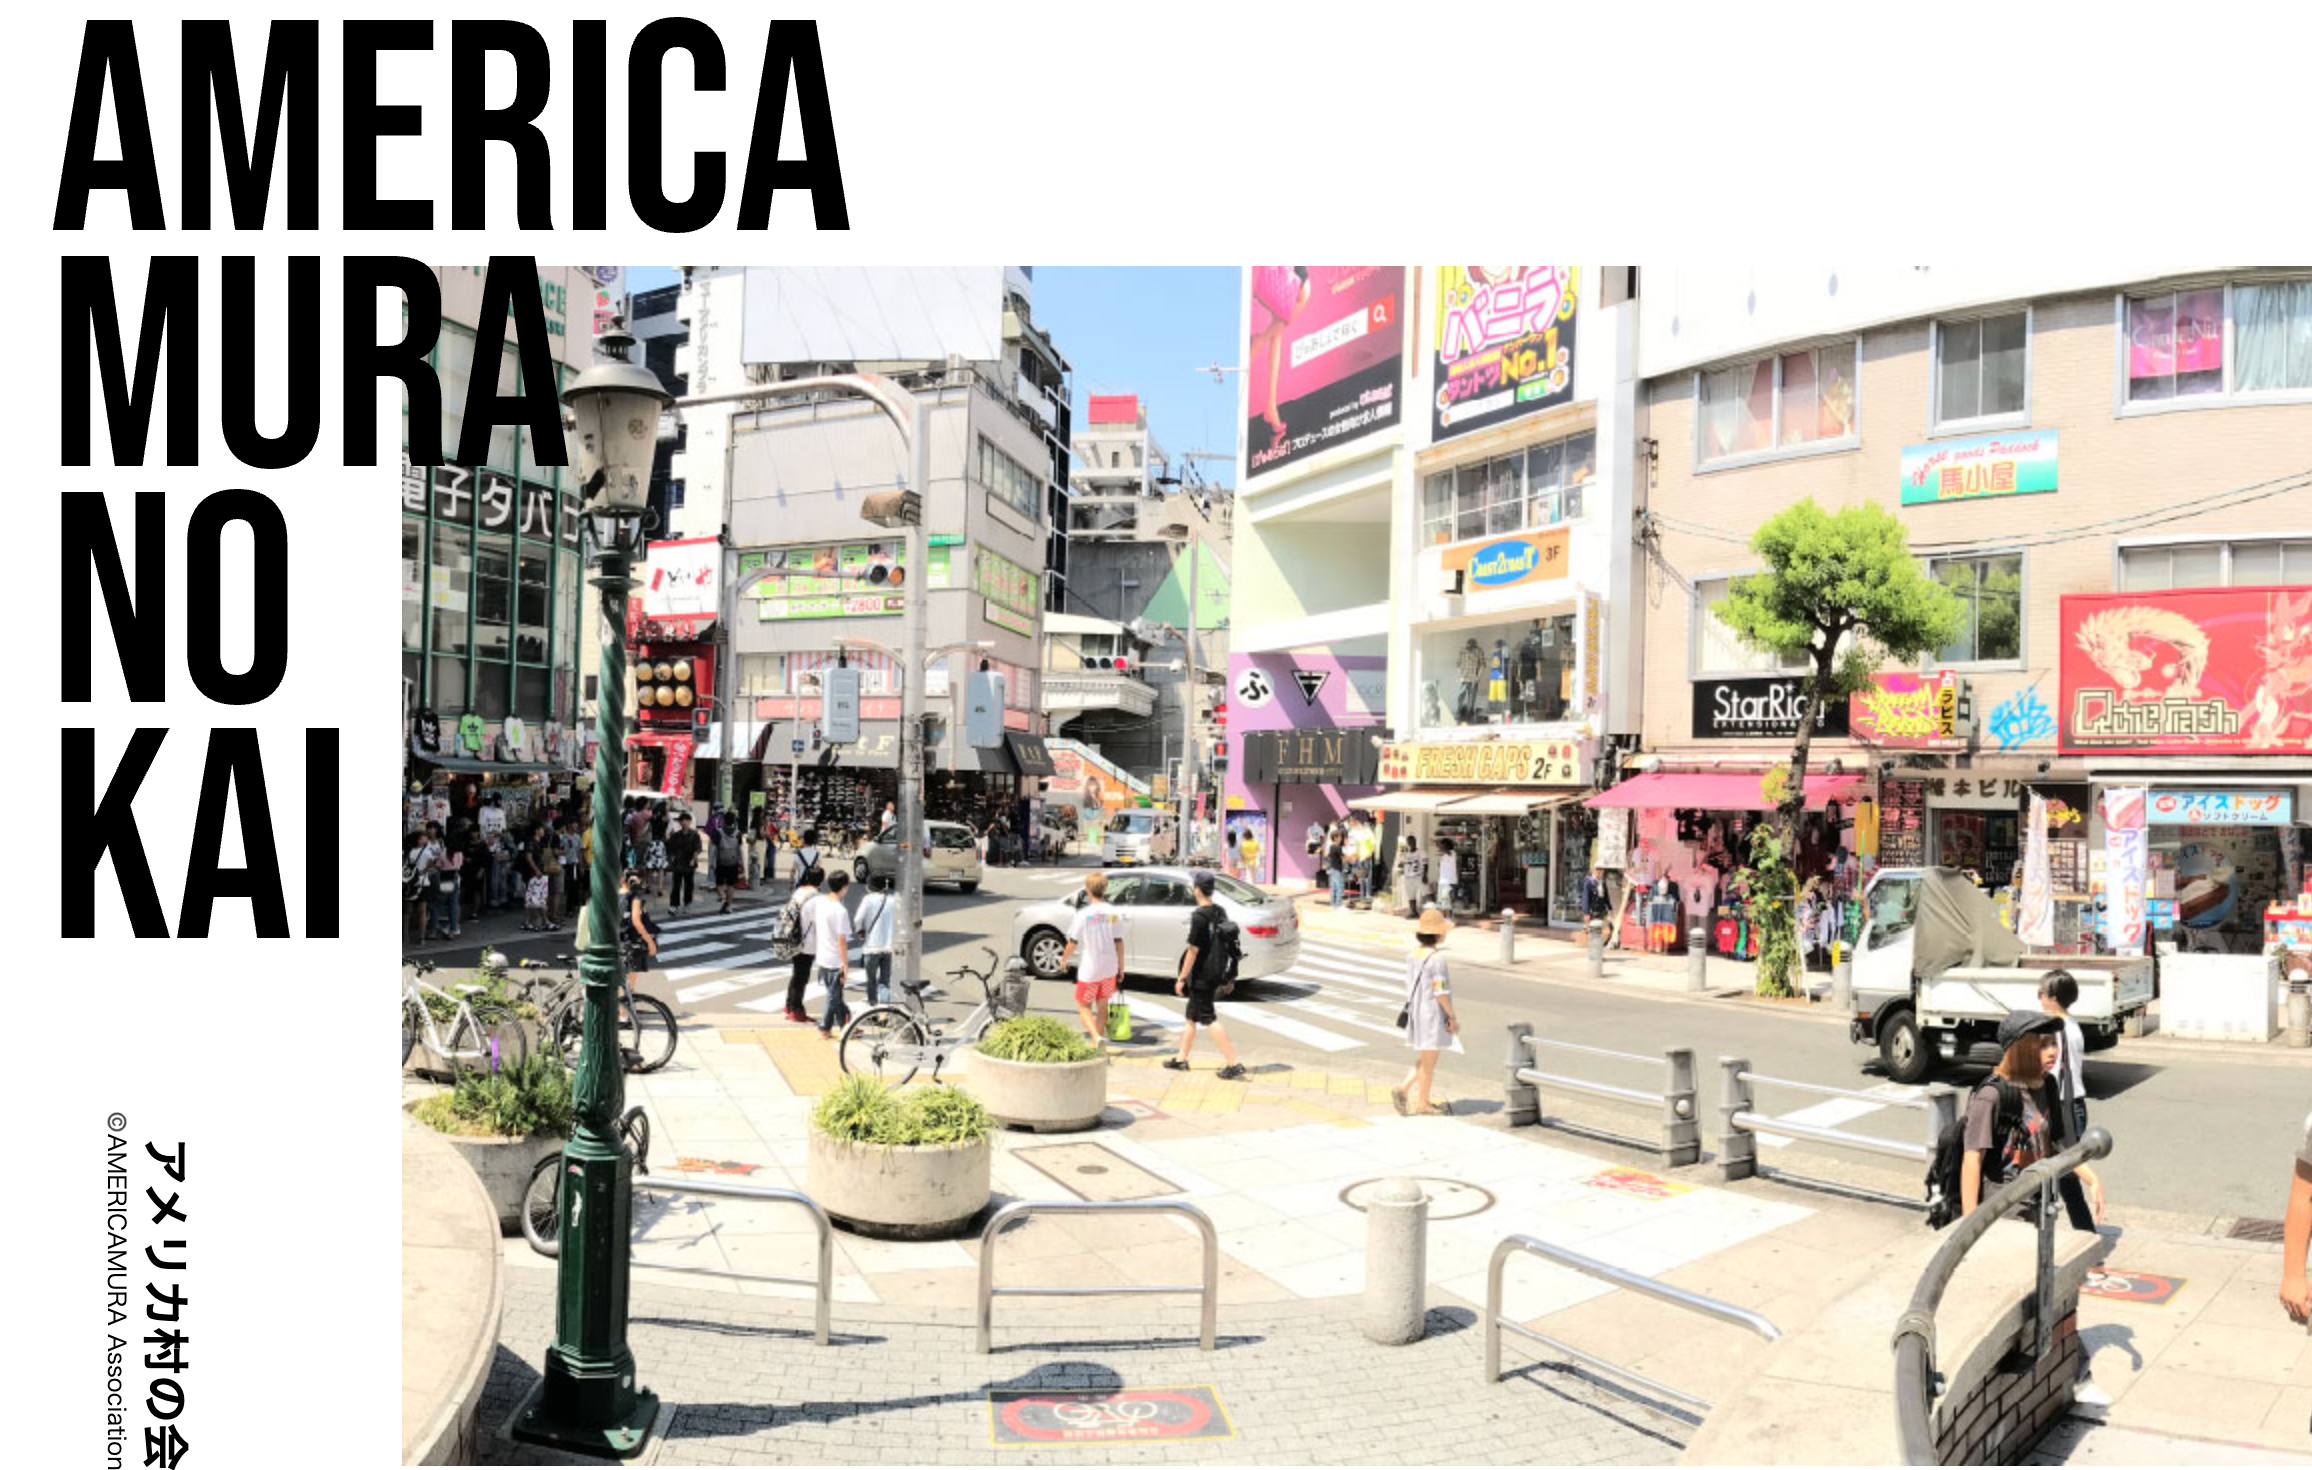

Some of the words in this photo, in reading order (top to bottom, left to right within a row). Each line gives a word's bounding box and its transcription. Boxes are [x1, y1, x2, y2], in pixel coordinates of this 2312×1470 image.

[1938, 461, 2015, 497] 馬小屋
[1239, 672, 1269, 700] ふ
[1416, 746, 1478, 779] FRESH
[1478, 745, 1533, 781] CAPS
[1533, 757, 1553, 779] 2F
[2181, 793, 2281, 811] アイスドッグ
[2204, 812, 2268, 821] ソフトクリーム
[2121, 829, 2142, 944] アイスドッグ
